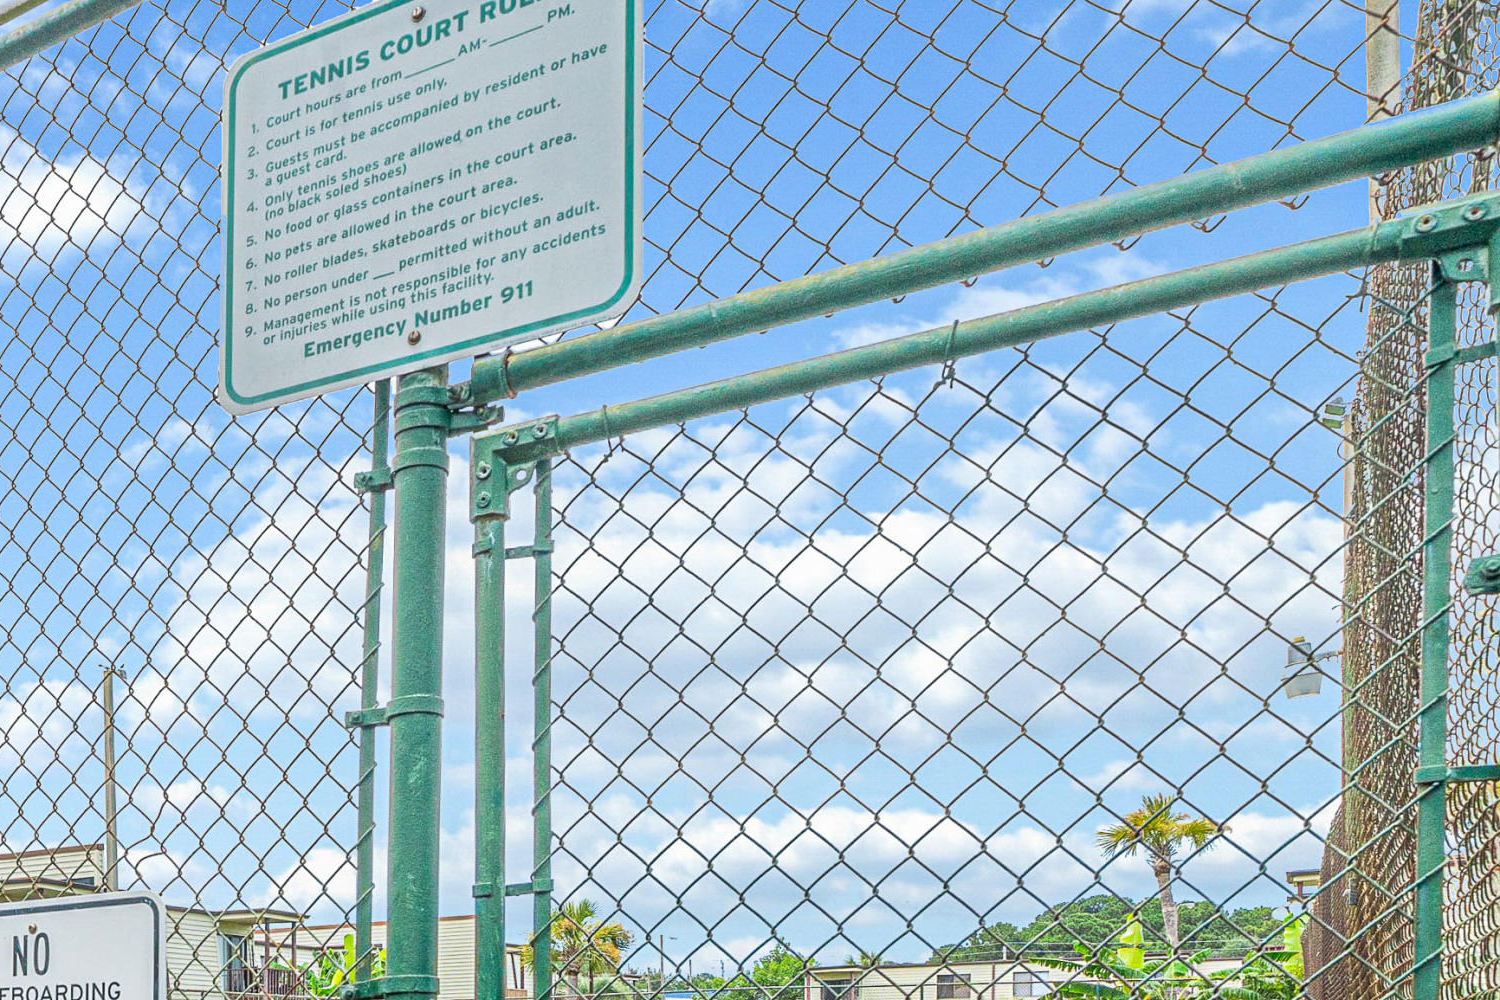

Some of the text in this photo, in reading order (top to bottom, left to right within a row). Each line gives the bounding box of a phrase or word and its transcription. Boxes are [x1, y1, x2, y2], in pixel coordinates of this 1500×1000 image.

[252, 124, 260, 134] 1.
[266, 106, 301, 129] Court
[305, 93, 342, 114] hours
[345, 84, 367, 99] are
[372, 68, 402, 89] from
[547, 3, 576, 24] PM.
[277, 49, 371, 101] TENNIS
[379, 9, 470, 62] COURT
[246, 96, 562, 213] 4. Only tennis shoes are allowed on the court.
[247, 43, 608, 180] 3. Guests must be accompanied by resident or have
[247, 77, 448, 158] 2. Court is for tennis use only.
[246, 132, 577, 248] 5. No food or glass containers in the court area.
[264, 149, 347, 187] a guest card.
[264, 162, 407, 222] (no black soled shoes)
[245, 176, 518, 270] 6. No pets are allowed in the court area.
[245, 192, 544, 292] 7. No roller blades, skateboards or bicycles.
[245, 199, 600, 315] 8. No person under permitted without an adult.
[244, 224, 606, 338] 9. Management is not responsible for any accidents
[263, 272, 492, 346] or injuries while using this facility.
[304, 280, 533, 358] Emergency Number 911
[12, 932, 50, 977] NO
